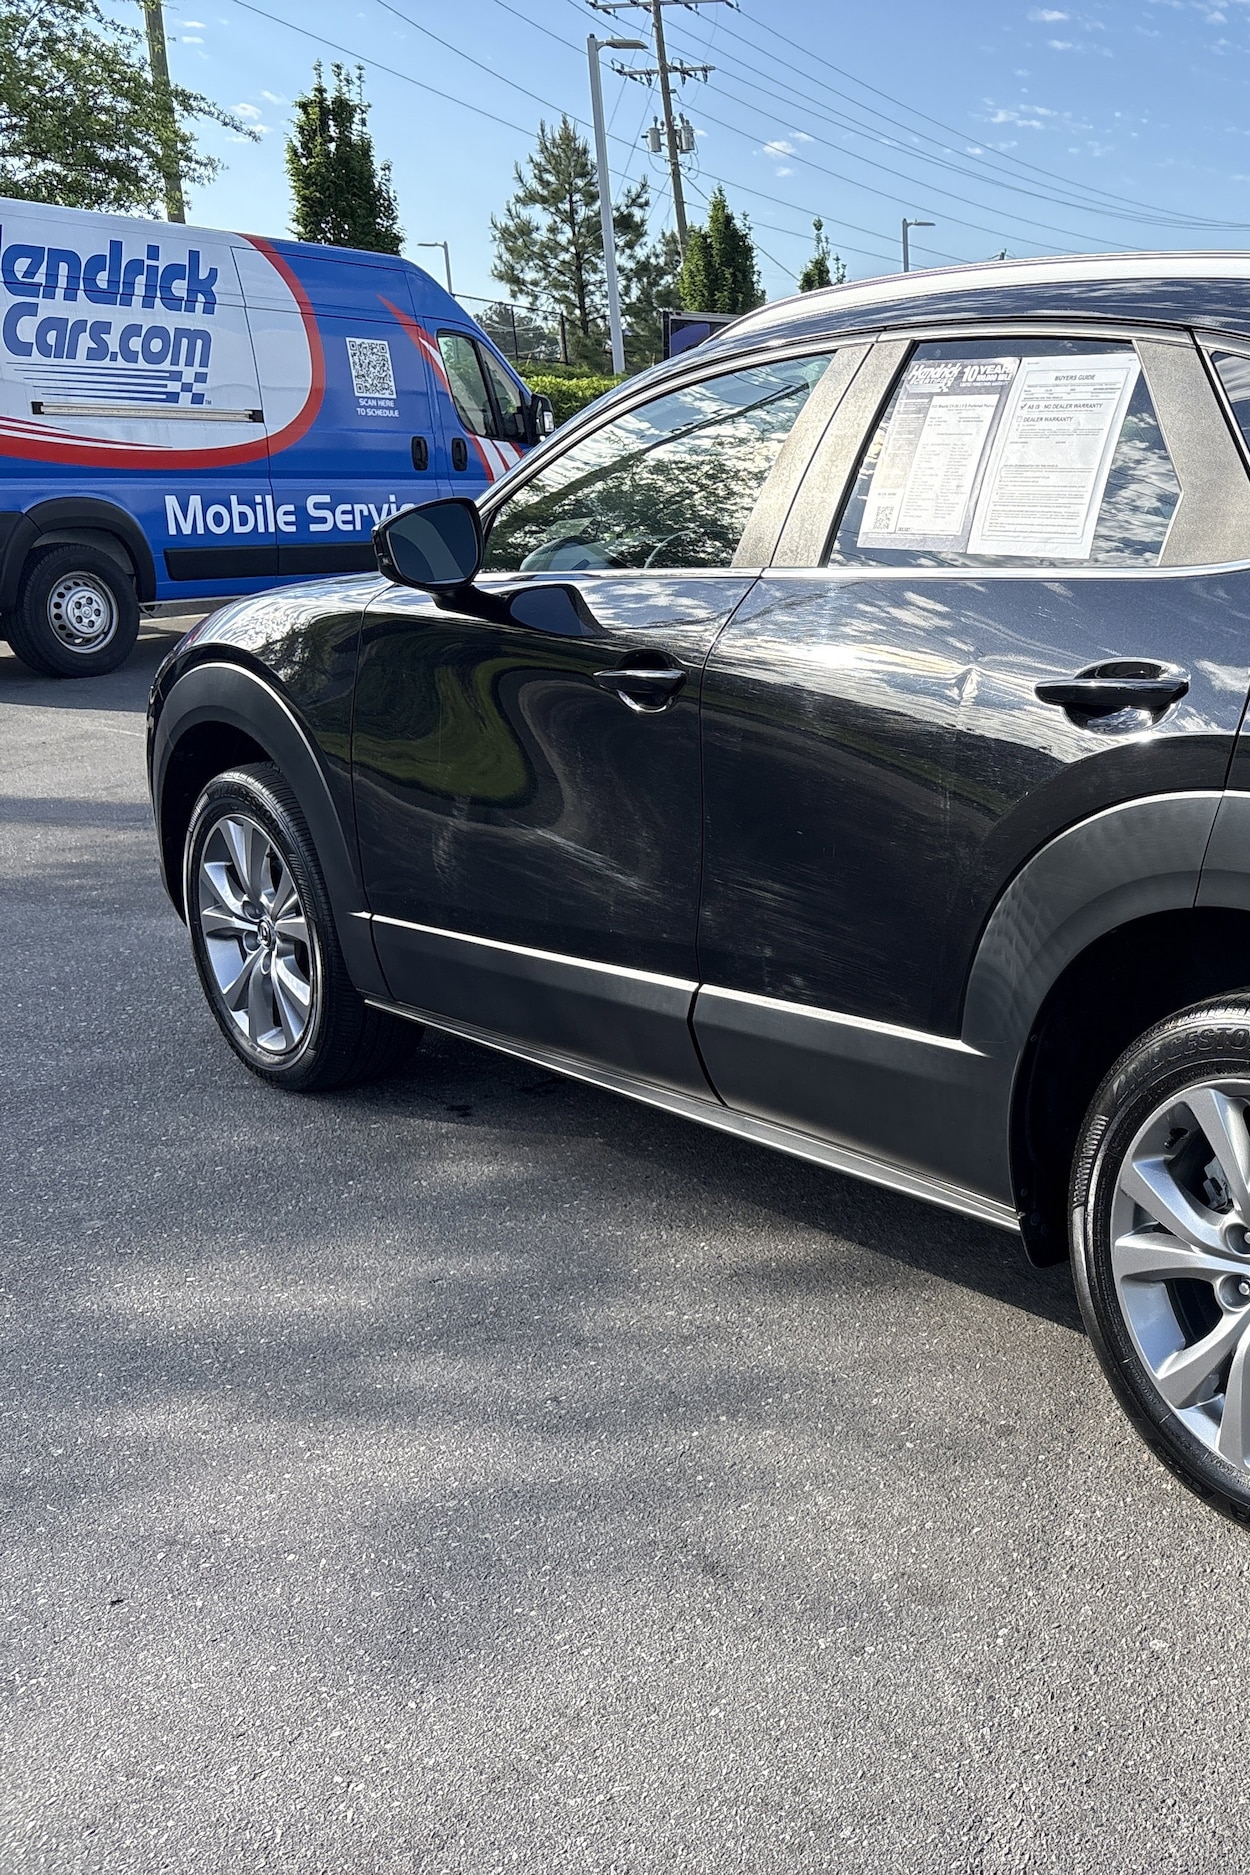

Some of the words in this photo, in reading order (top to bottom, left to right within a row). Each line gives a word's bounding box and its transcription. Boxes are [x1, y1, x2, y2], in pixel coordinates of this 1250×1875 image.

[0, 224, 218, 315] endrick
[2, 301, 212, 368] Cars.com
[962, 365, 980, 382] 10
[356, 408, 366, 416] TO
[366, 408, 400, 418] SCHEDULE
[359, 398, 377, 407] SCAN
[377, 399, 395, 408] HERE
[164, 494, 297, 536] Mobile
